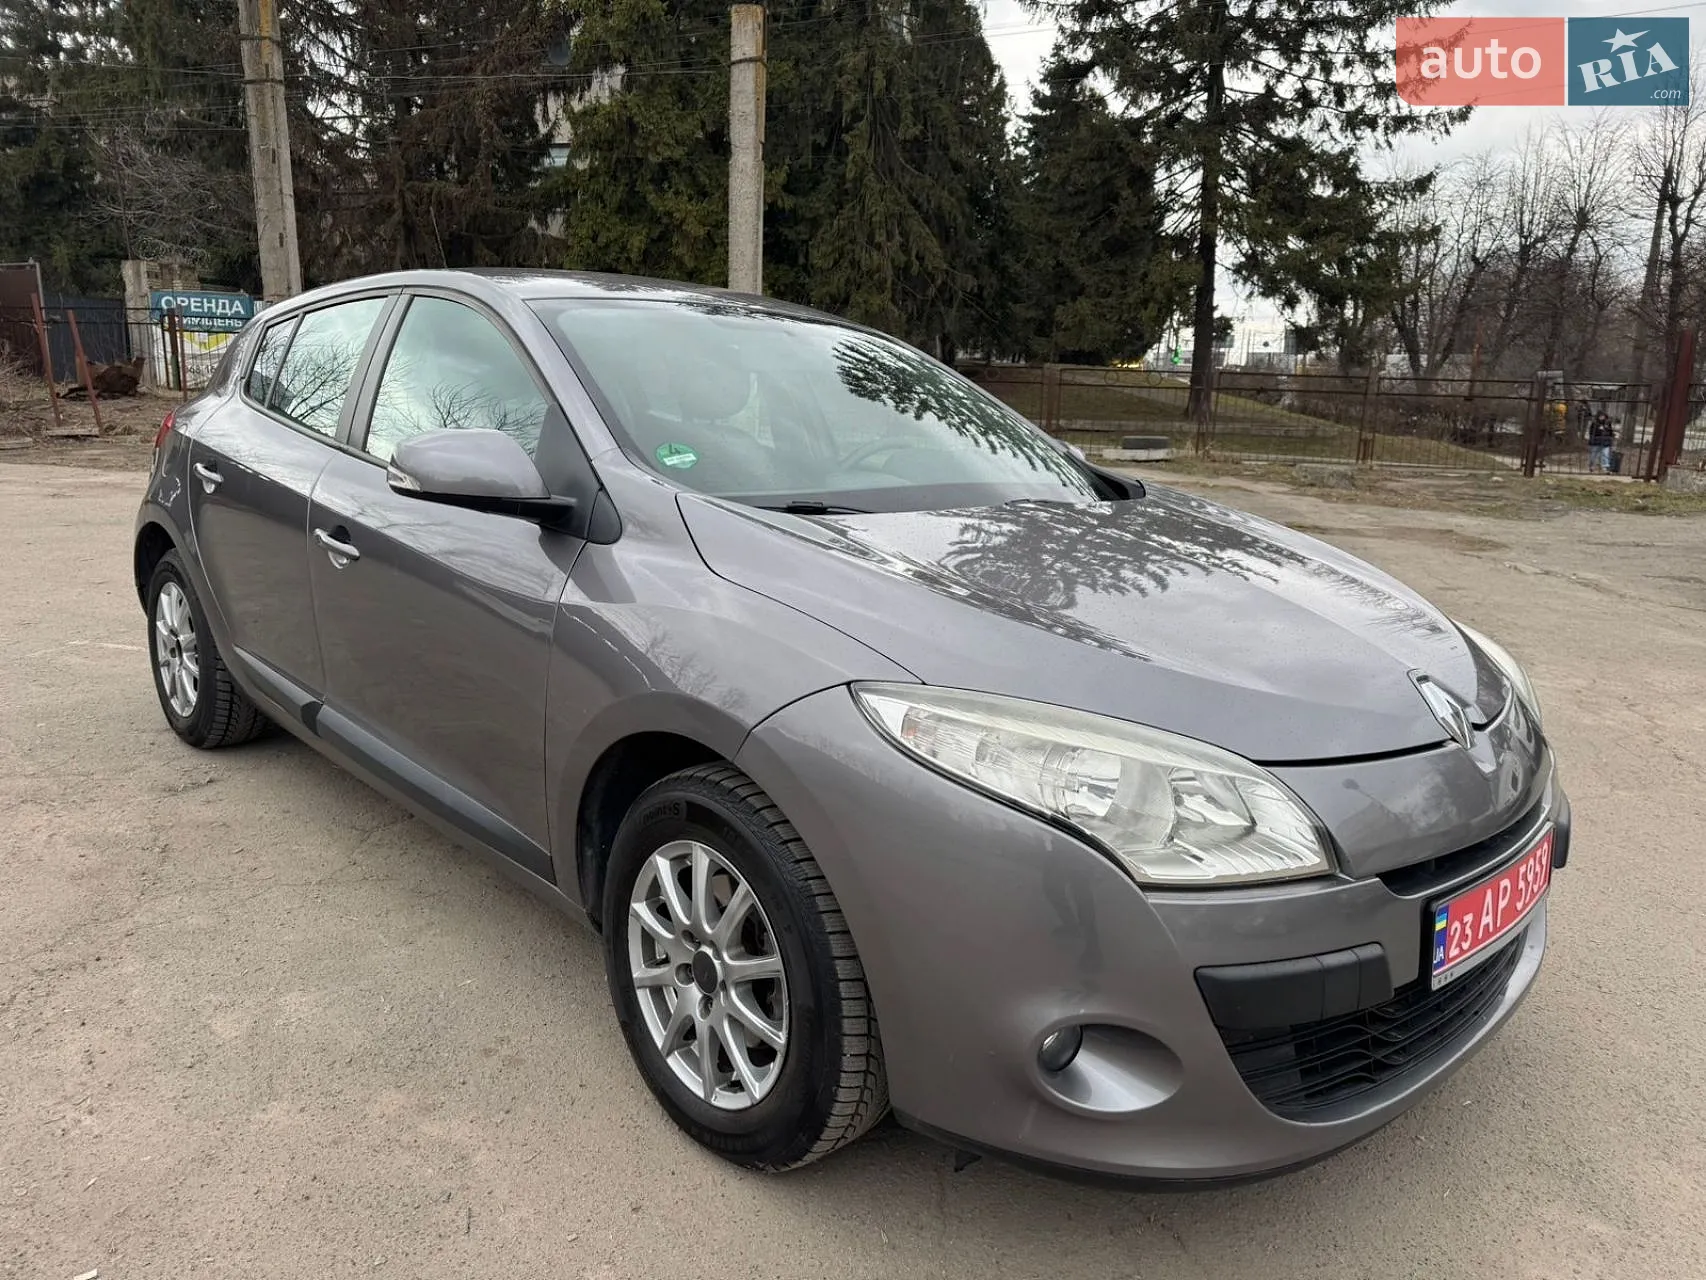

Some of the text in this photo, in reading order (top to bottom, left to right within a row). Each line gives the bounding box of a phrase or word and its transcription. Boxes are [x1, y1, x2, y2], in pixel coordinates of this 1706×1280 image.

[161, 295, 245, 316] ОРЕНДА
[1449, 841, 1549, 958] 23 AP 5959
